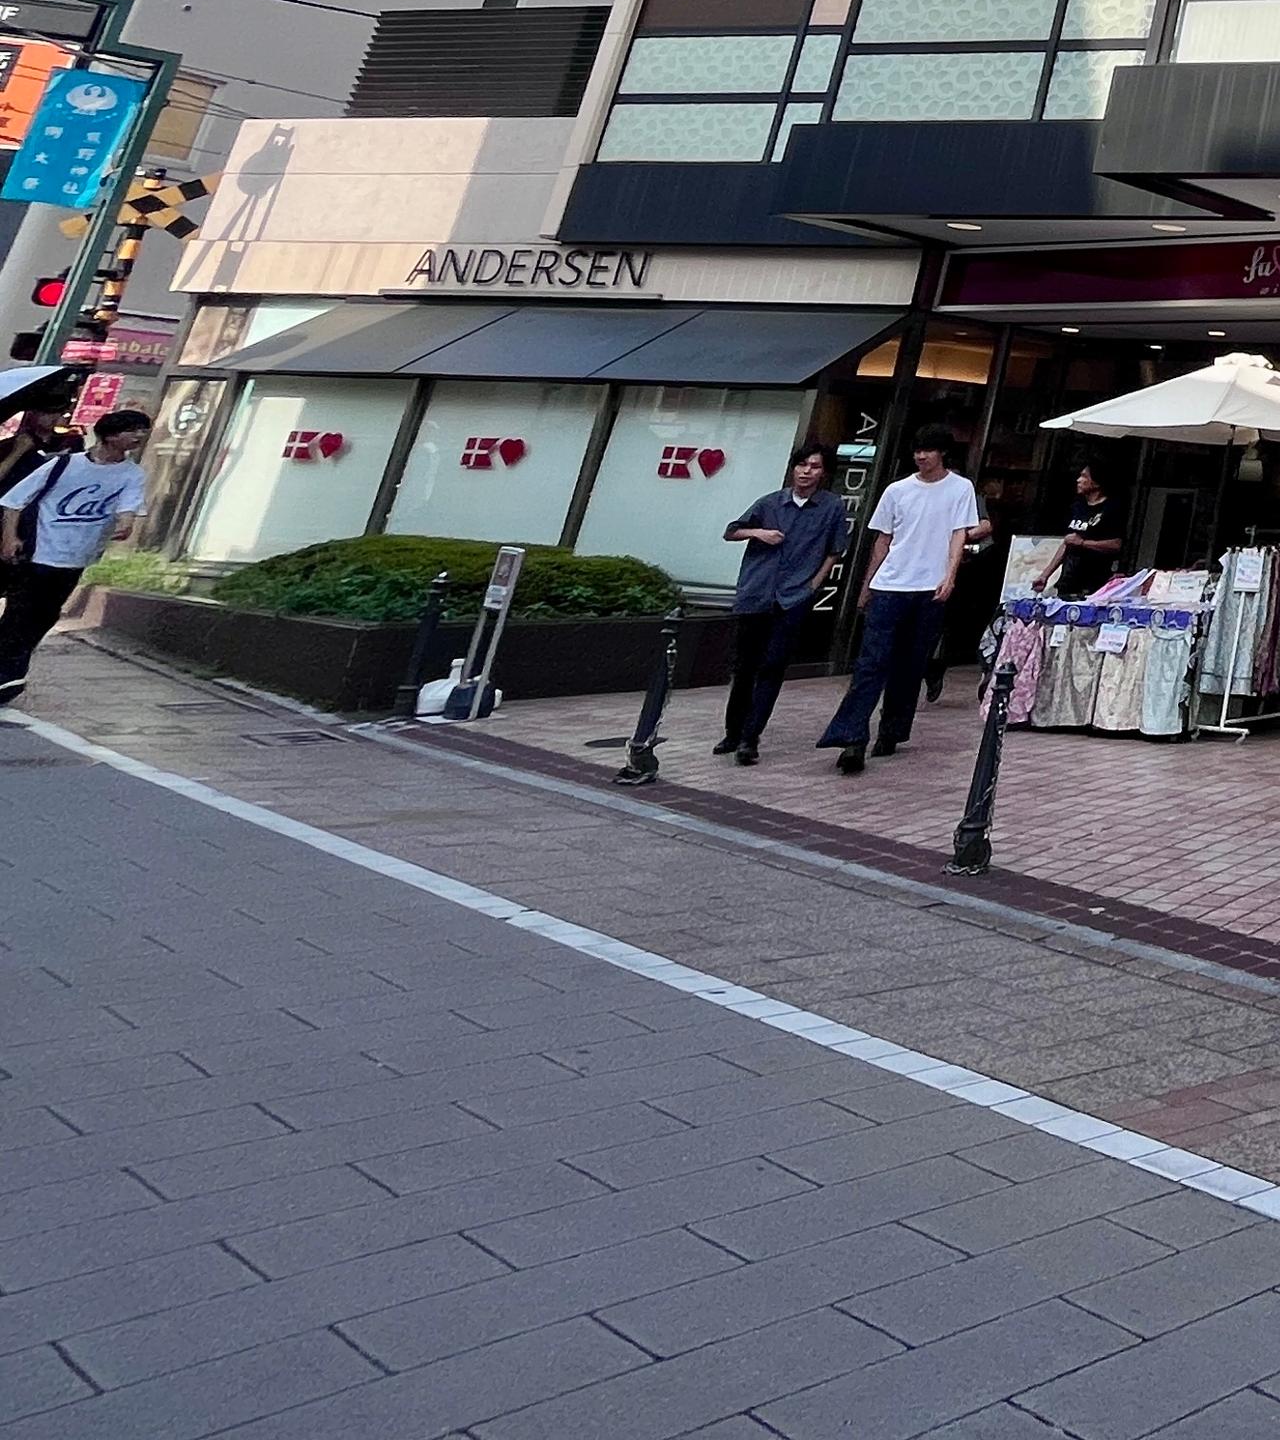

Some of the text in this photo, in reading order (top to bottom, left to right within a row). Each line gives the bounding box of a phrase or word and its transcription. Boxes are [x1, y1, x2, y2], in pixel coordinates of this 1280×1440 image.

[405, 247, 653, 289] ANDERSEN
[56, 483, 127, 518] Cal
[812, 410, 879, 613] ANDEEN
